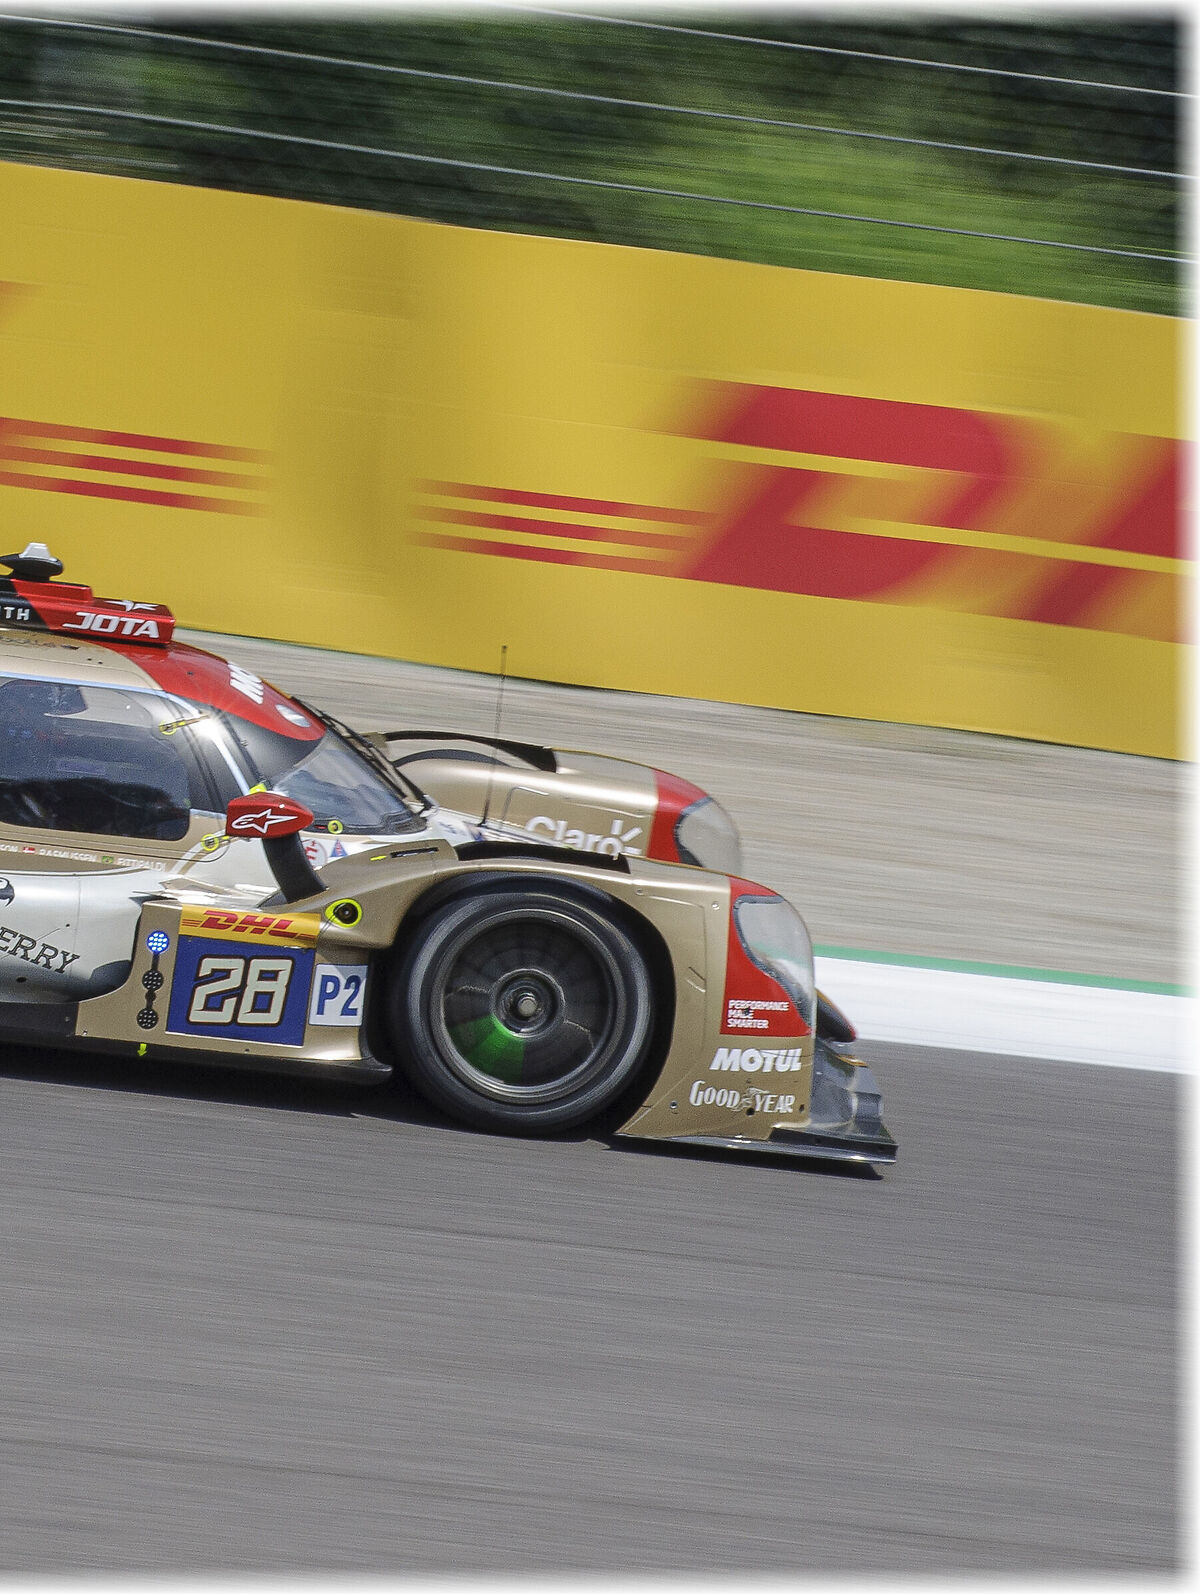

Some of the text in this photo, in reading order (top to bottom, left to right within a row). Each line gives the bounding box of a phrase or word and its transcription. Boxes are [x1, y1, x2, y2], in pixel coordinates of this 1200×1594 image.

[62, 611, 161, 639] JOTA
[200, 909, 298, 939] DHL
[188, 955, 295, 1025] 28
[316, 974, 362, 1017] P2
[728, 999, 790, 1011] PERFORMANCE
[727, 1018, 770, 1029] SMARTER
[708, 1047, 803, 1073] MOTUL
[689, 1080, 796, 1113] GOOD YEAR
